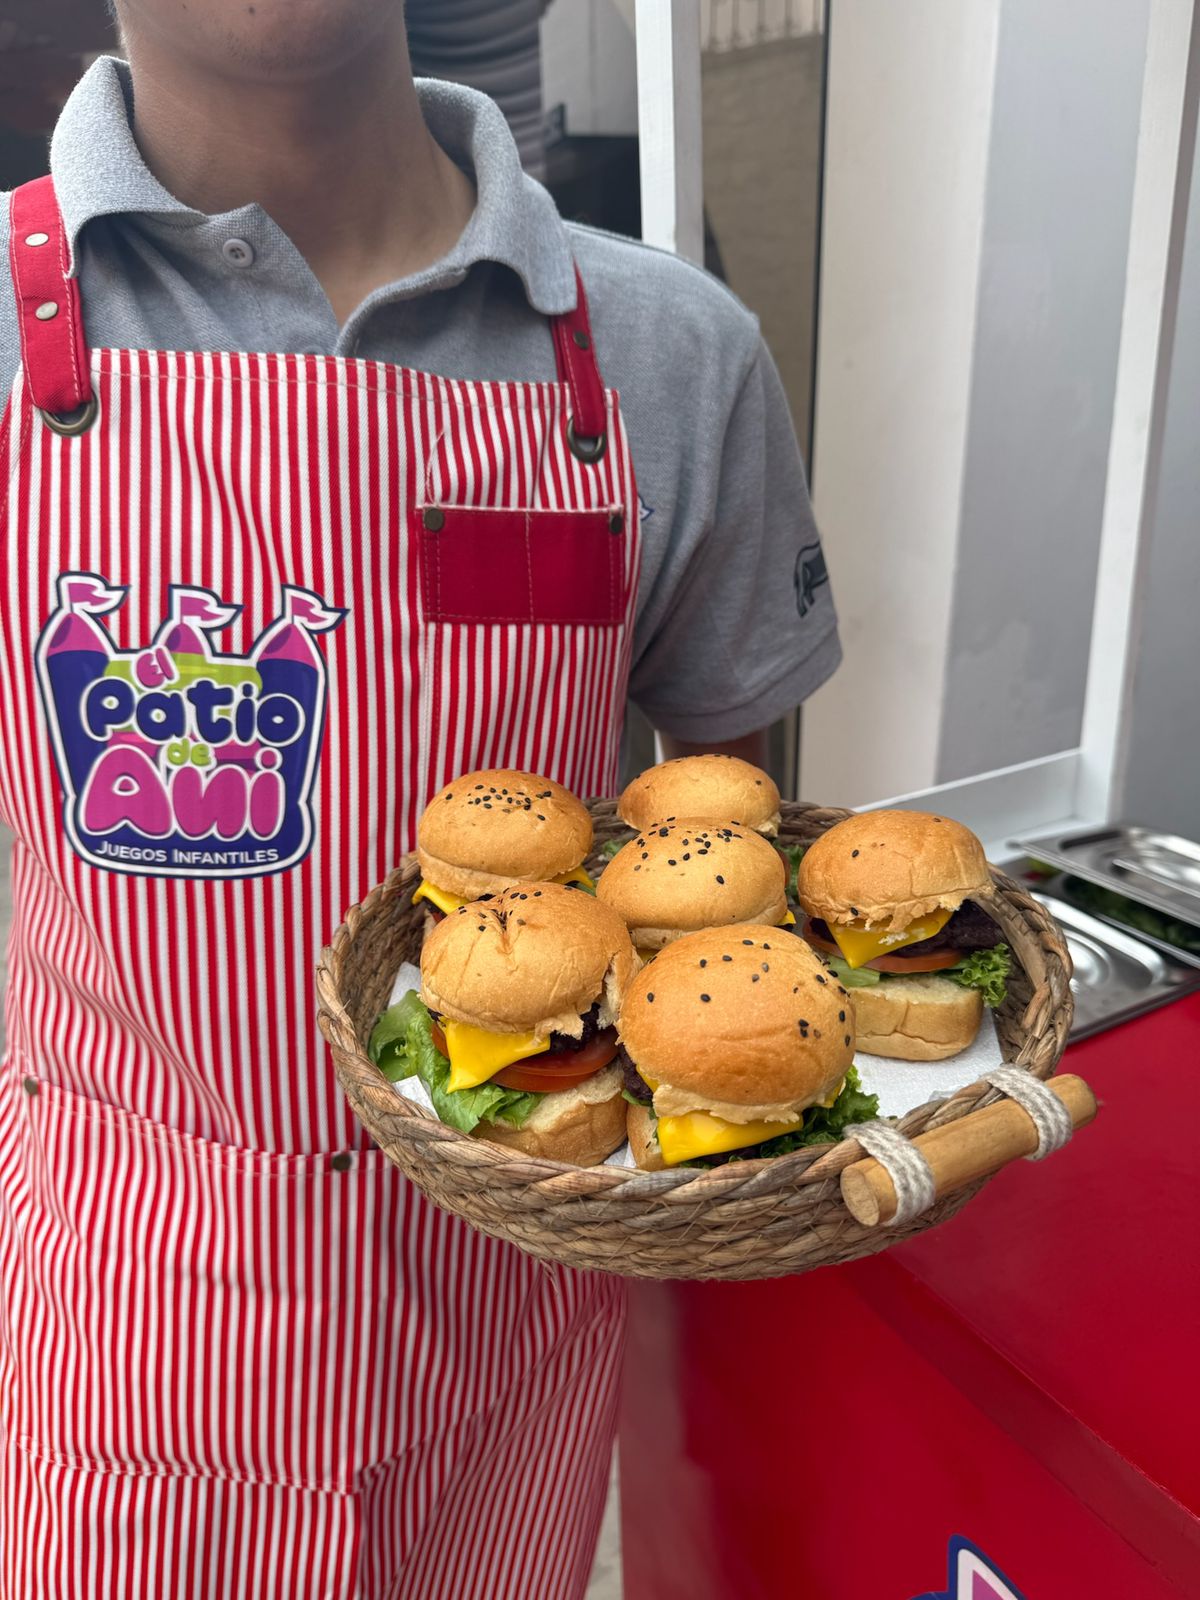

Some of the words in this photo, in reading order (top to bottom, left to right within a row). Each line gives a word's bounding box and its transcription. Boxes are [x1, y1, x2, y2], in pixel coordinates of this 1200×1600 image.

[166, 738, 212, 766] de
[97, 841, 167, 862] JUEGOS
[173, 849, 279, 865] INFANTILES
